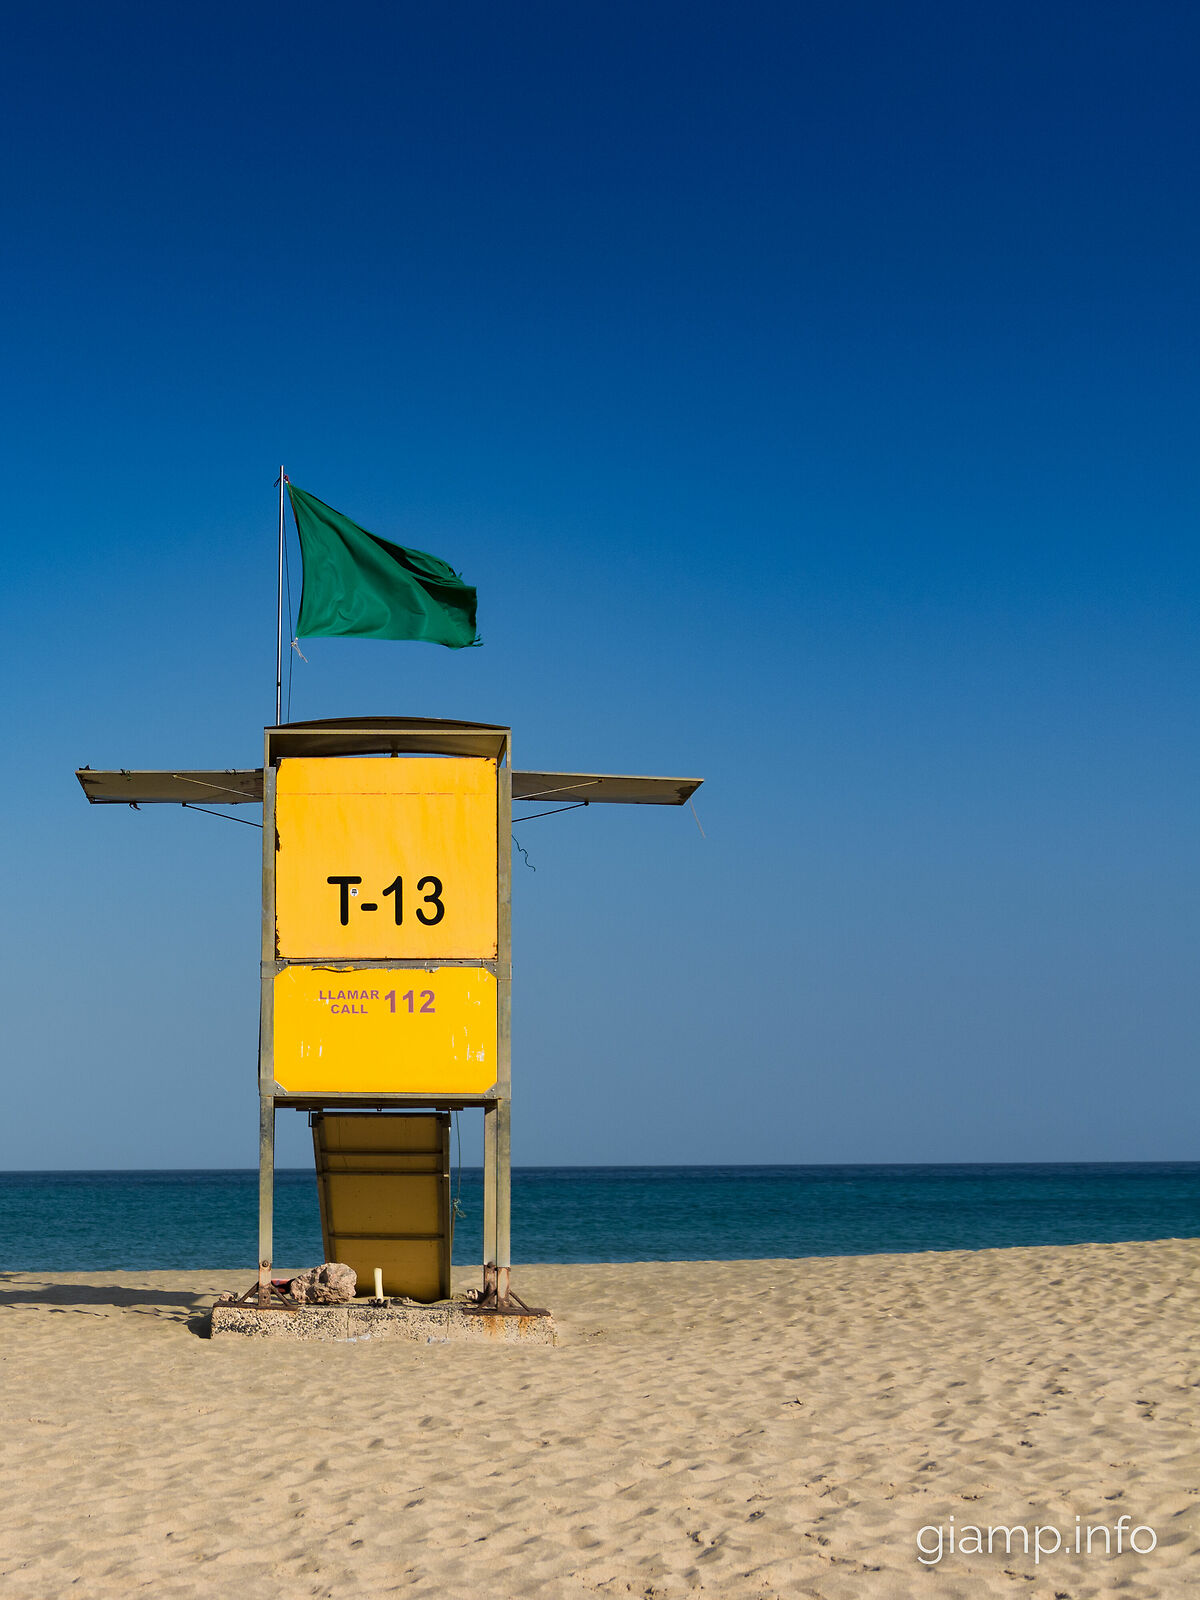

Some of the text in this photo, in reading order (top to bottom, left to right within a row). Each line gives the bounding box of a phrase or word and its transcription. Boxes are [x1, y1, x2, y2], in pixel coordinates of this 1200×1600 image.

[327, 875, 445, 926] T-13
[319, 990, 380, 1000] LLAMAR
[384, 990, 436, 1013] 112
[330, 1004, 368, 1014] CALL
